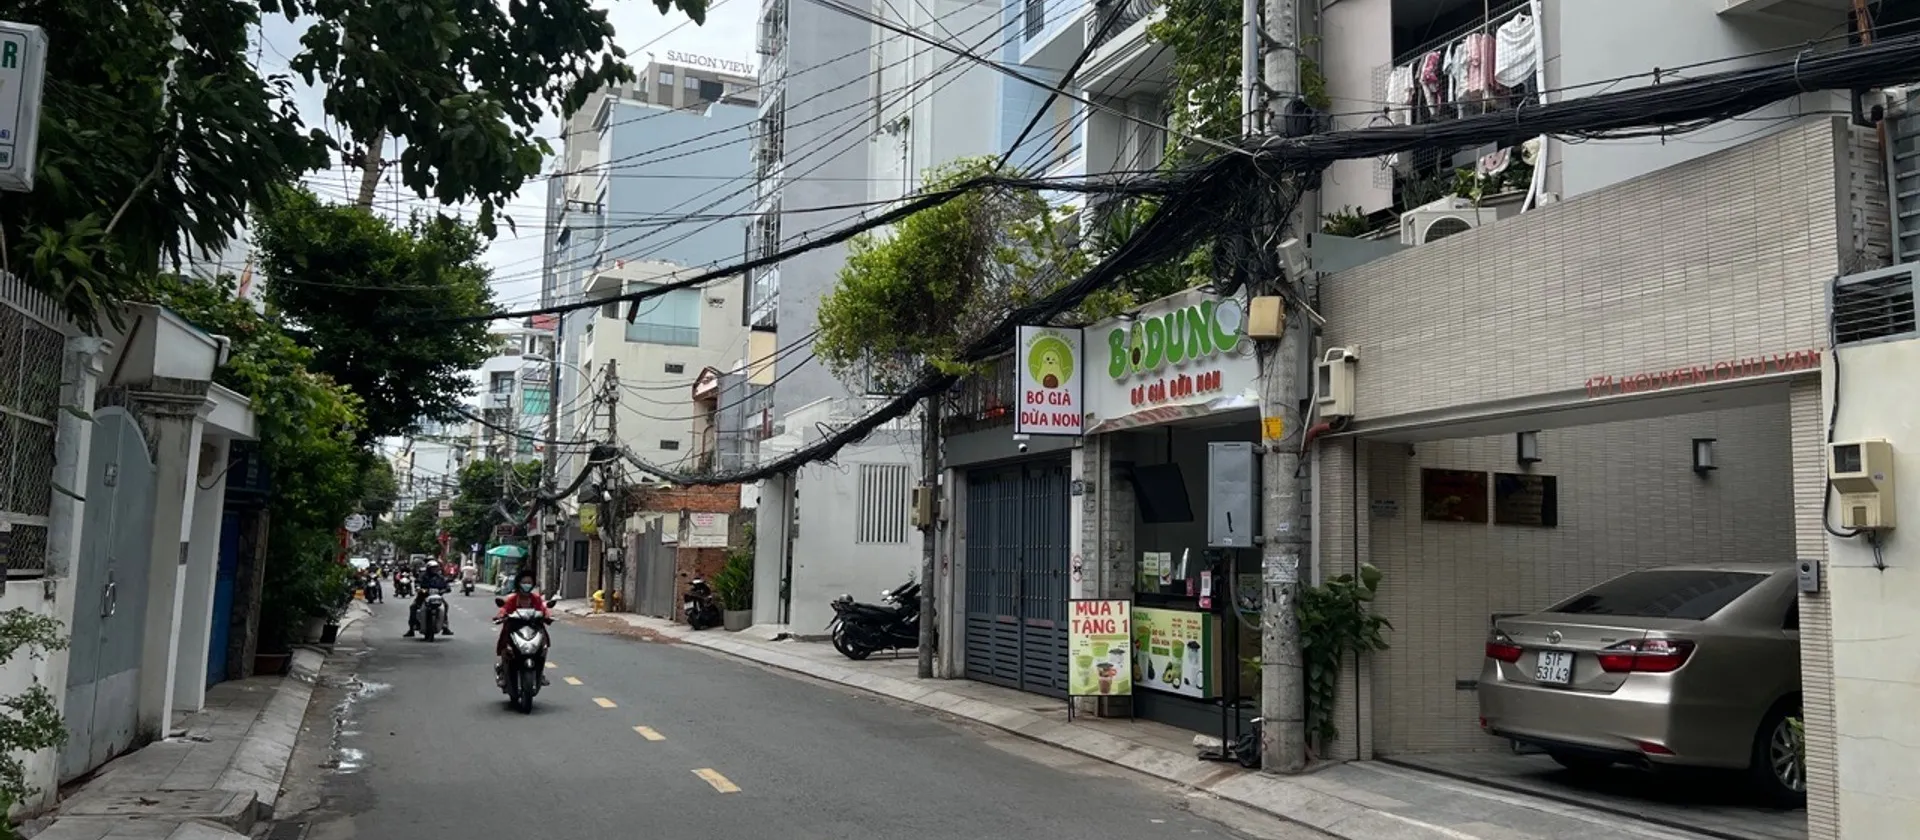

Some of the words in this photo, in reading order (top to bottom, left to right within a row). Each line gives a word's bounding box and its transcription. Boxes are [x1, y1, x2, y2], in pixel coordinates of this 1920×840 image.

[667, 50, 717, 69] SAIGON
[718, 59, 754, 74] VIEW
[1196, 370, 1221, 393] NON
[1585, 374, 1613, 398] 171
[1026, 389, 1044, 404] BƠ
[1048, 388, 1071, 406] GIÀ
[1022, 408, 1048, 426] DỪA
[1052, 412, 1080, 427] NON
[1075, 600, 1111, 616] MUA
[1117, 601, 1123, 615] 1
[1122, 619, 1128, 633] 1
[1545, 652, 1564, 666] 51F
[1536, 666, 1569, 682] 531.43
